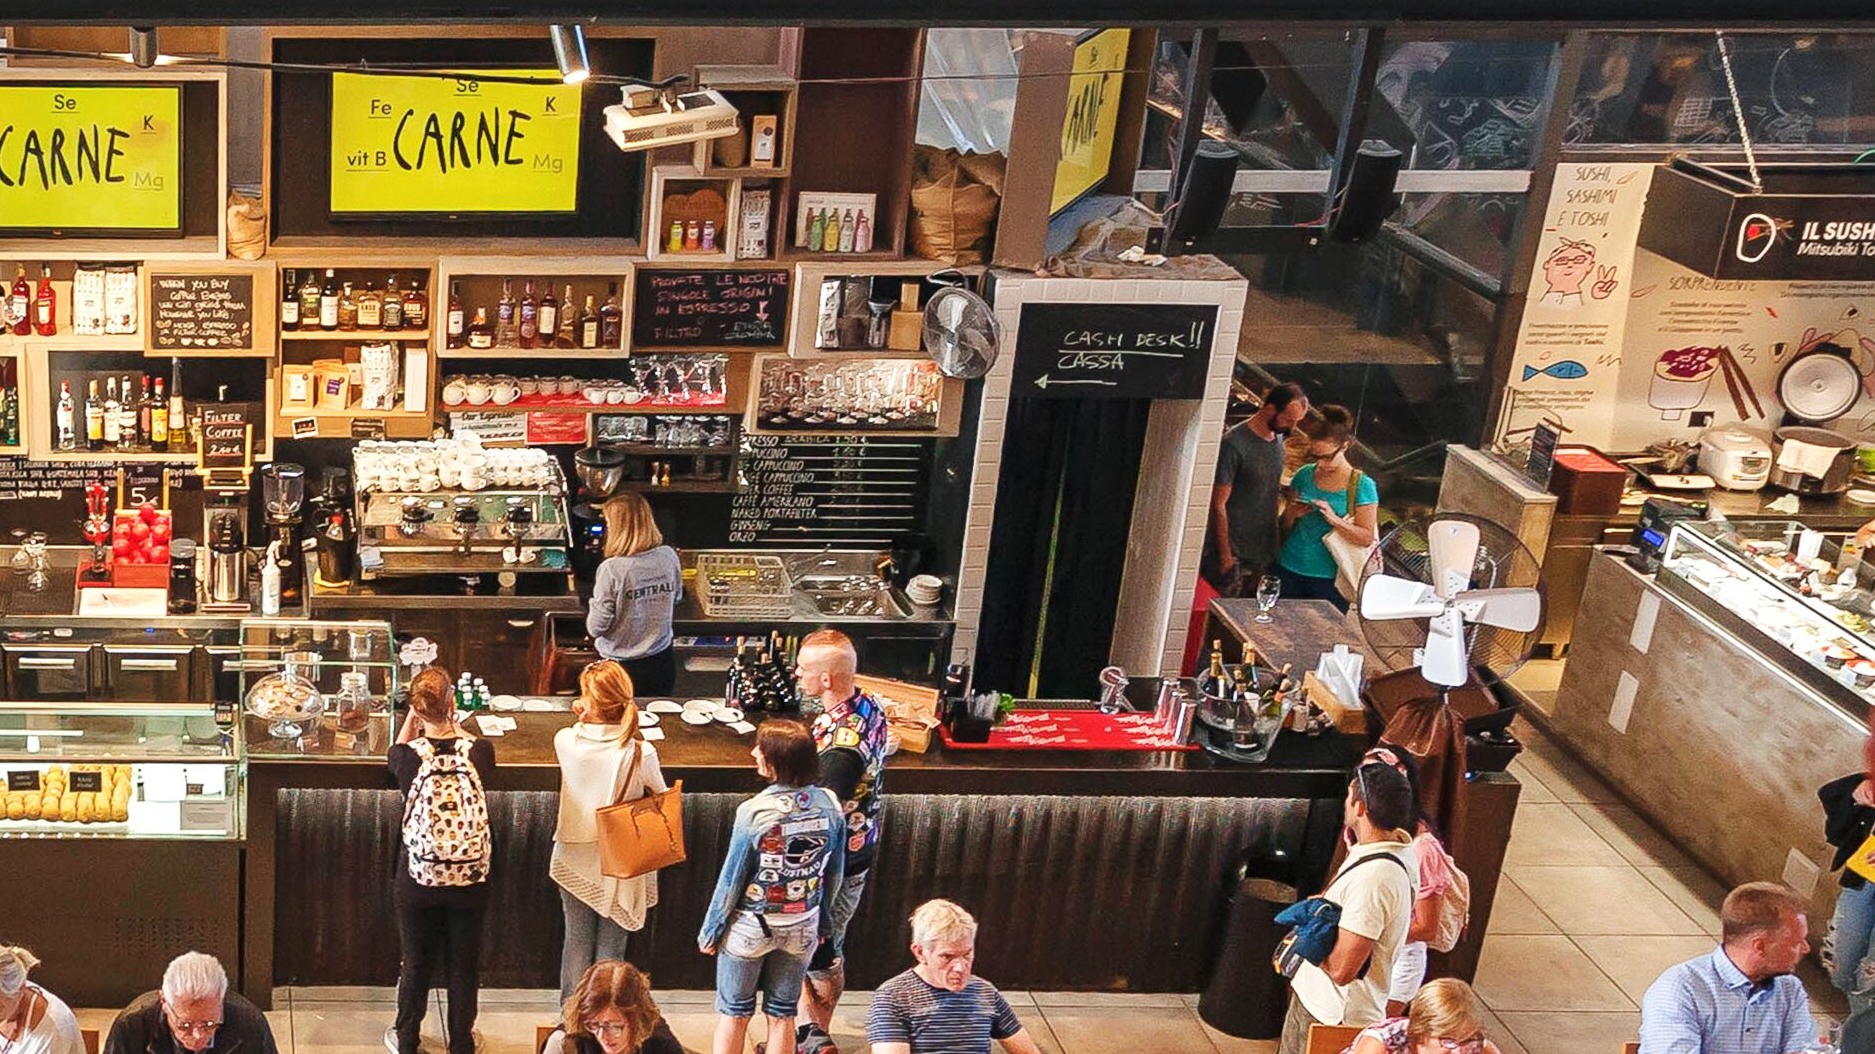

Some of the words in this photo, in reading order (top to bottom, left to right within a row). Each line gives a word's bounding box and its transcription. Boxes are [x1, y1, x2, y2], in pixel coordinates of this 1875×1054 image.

[457, 79, 479, 93] Se
[54, 94, 77, 110] Se
[371, 100, 392, 115] Fe
[545, 97, 557, 112] K
[143, 115, 154, 131] K
[393, 107, 531, 174] CARNE
[347, 151, 369, 166] vit
[376, 152, 387, 166] B
[533, 154, 563, 174] Mg
[135, 172, 164, 191] Mg
[1576, 167, 1611, 184] SUSHI,
[1566, 189, 1617, 205] SASHIMI
[1572, 210, 1610, 227] TOSHI
[1802, 222, 1820, 240] IL
[1064, 330, 1124, 347] CASH
[1057, 352, 1124, 371] CASSA
[760, 496, 814, 507] AMERICANO
